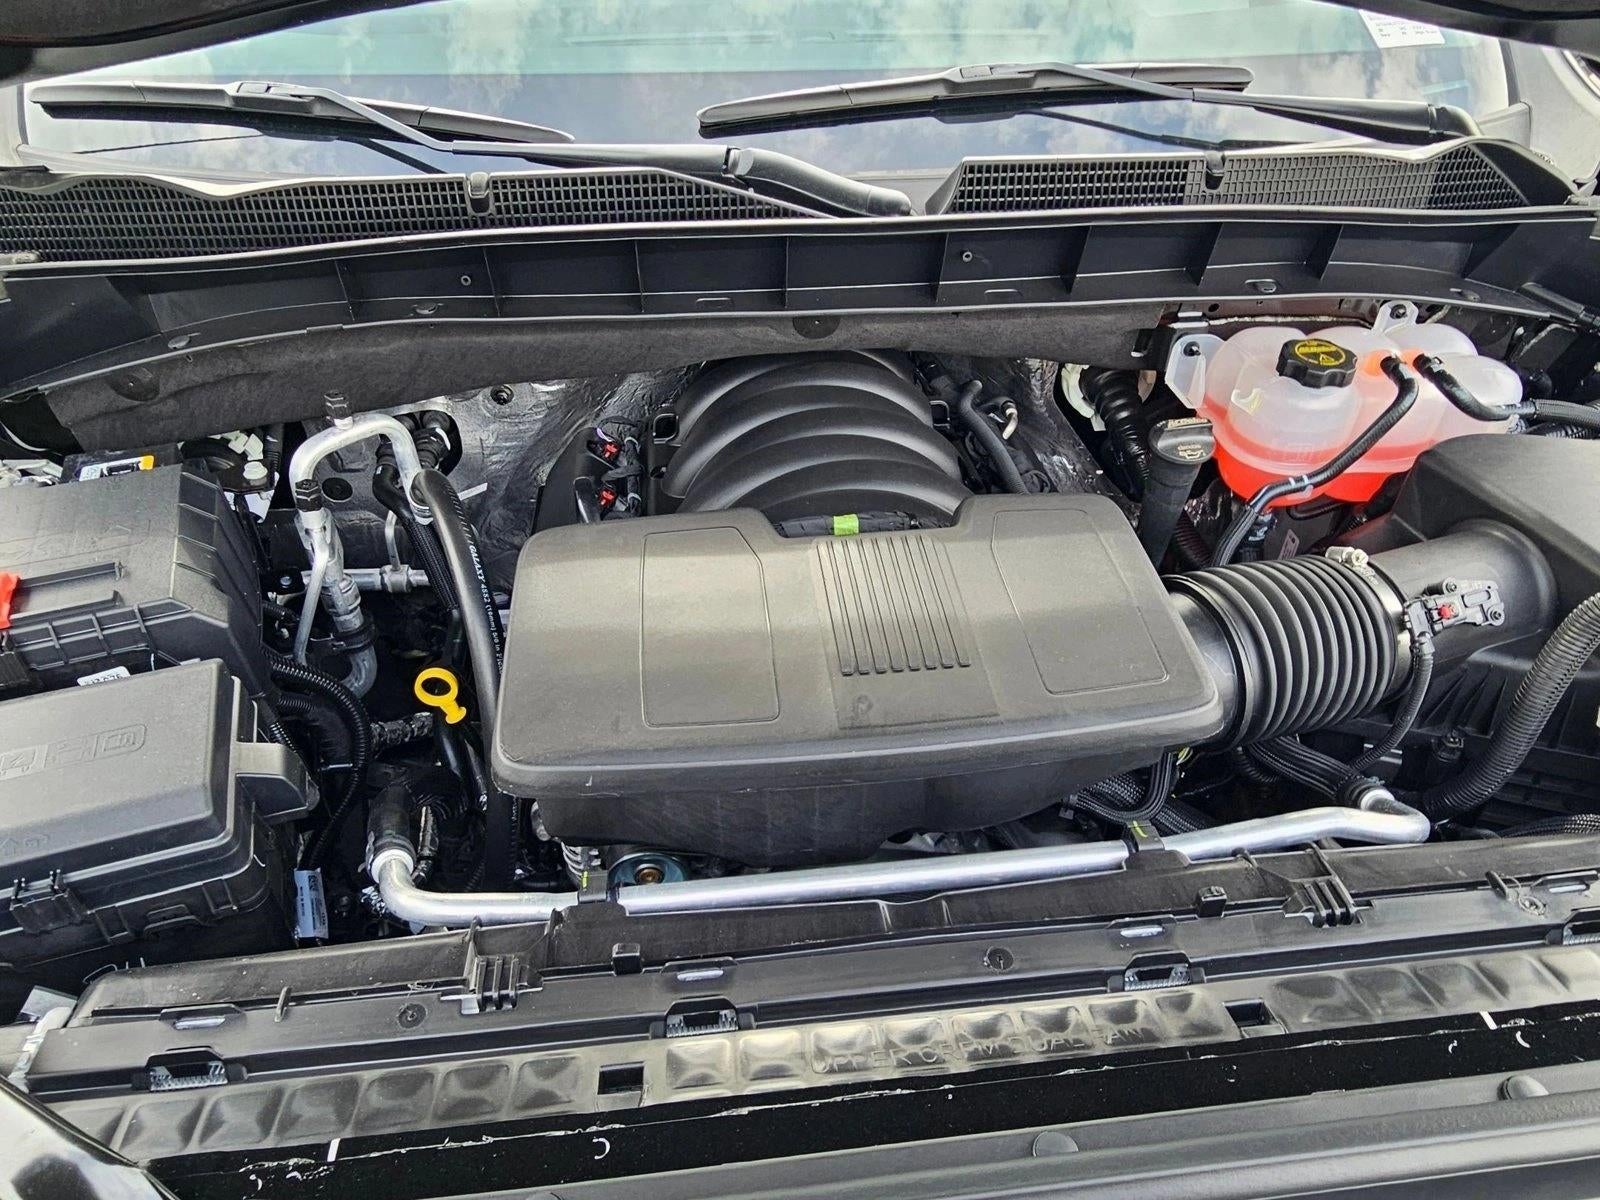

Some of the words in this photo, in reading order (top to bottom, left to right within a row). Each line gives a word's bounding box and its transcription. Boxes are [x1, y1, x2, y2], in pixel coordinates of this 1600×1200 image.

[469, 545, 486, 583] GALAXY
[821, 1047, 912, 1074] UPPER
[1006, 1034, 1086, 1055] DUAL
